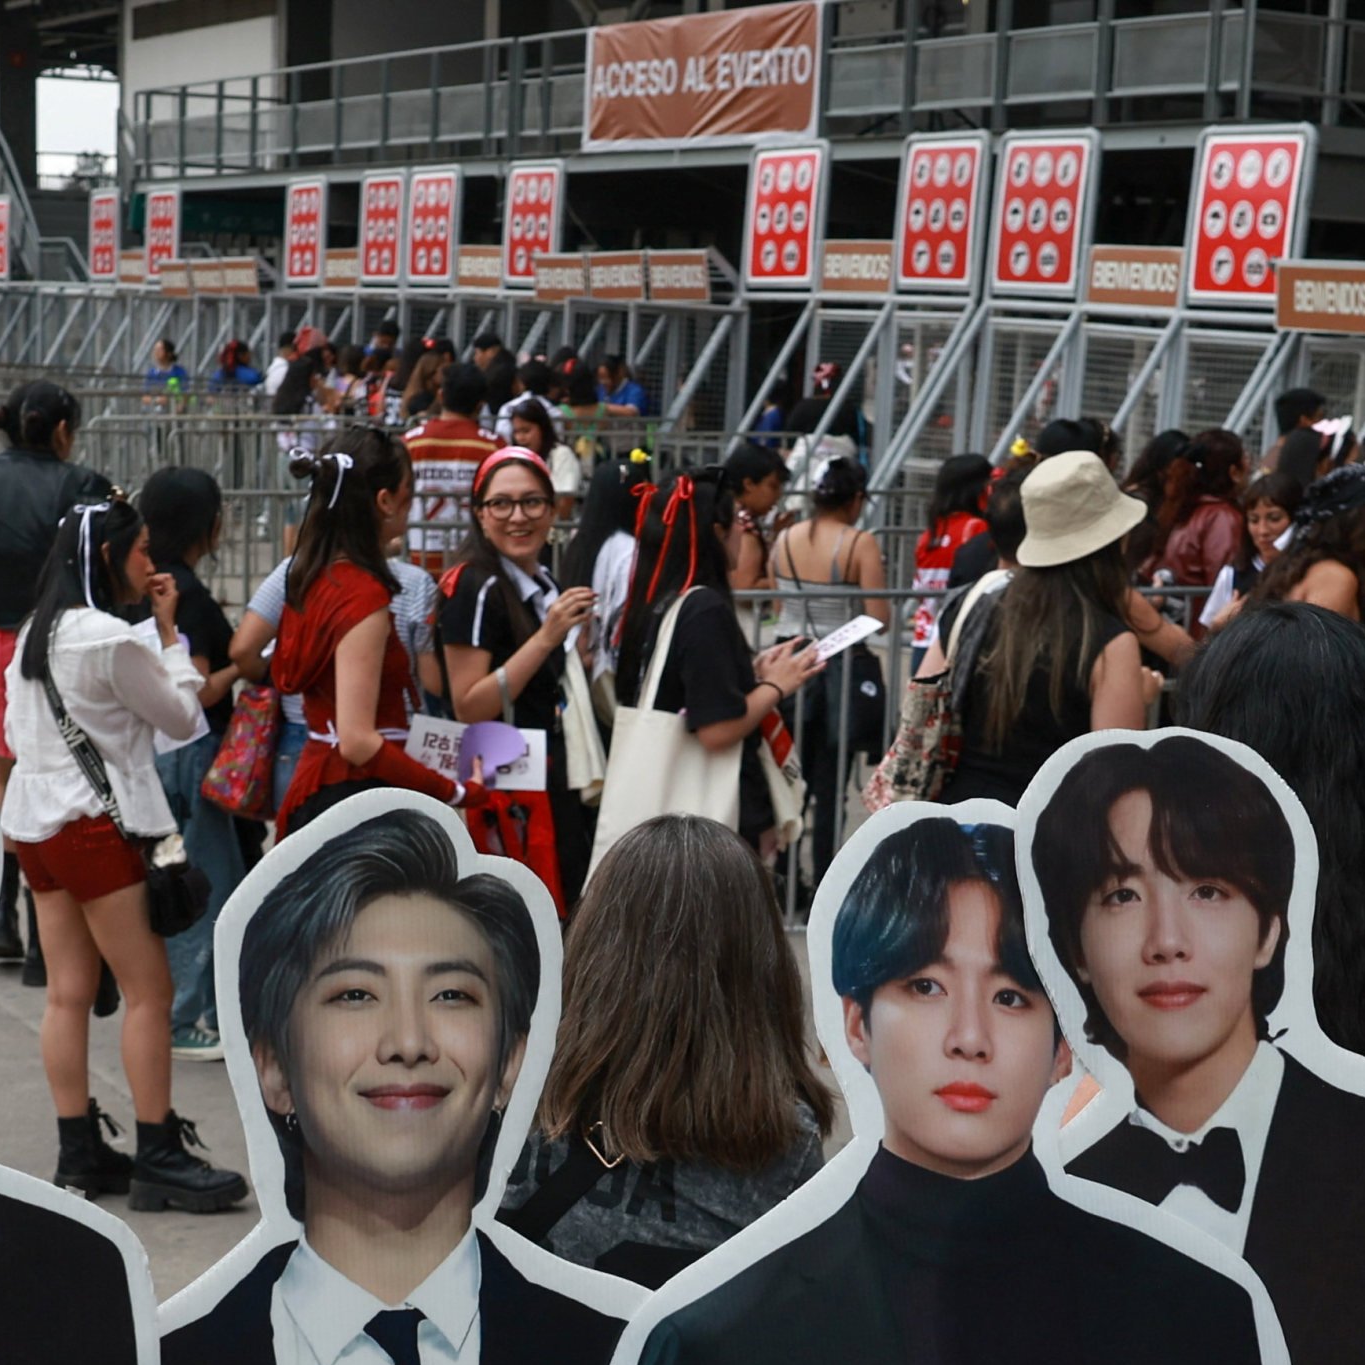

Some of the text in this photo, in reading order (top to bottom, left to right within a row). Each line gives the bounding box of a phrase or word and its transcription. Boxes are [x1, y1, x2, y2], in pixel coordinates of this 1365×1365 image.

[593, 44, 812, 98] ACCESO AL EVENTO
[1092, 260, 1179, 292] BIENVENIDOS
